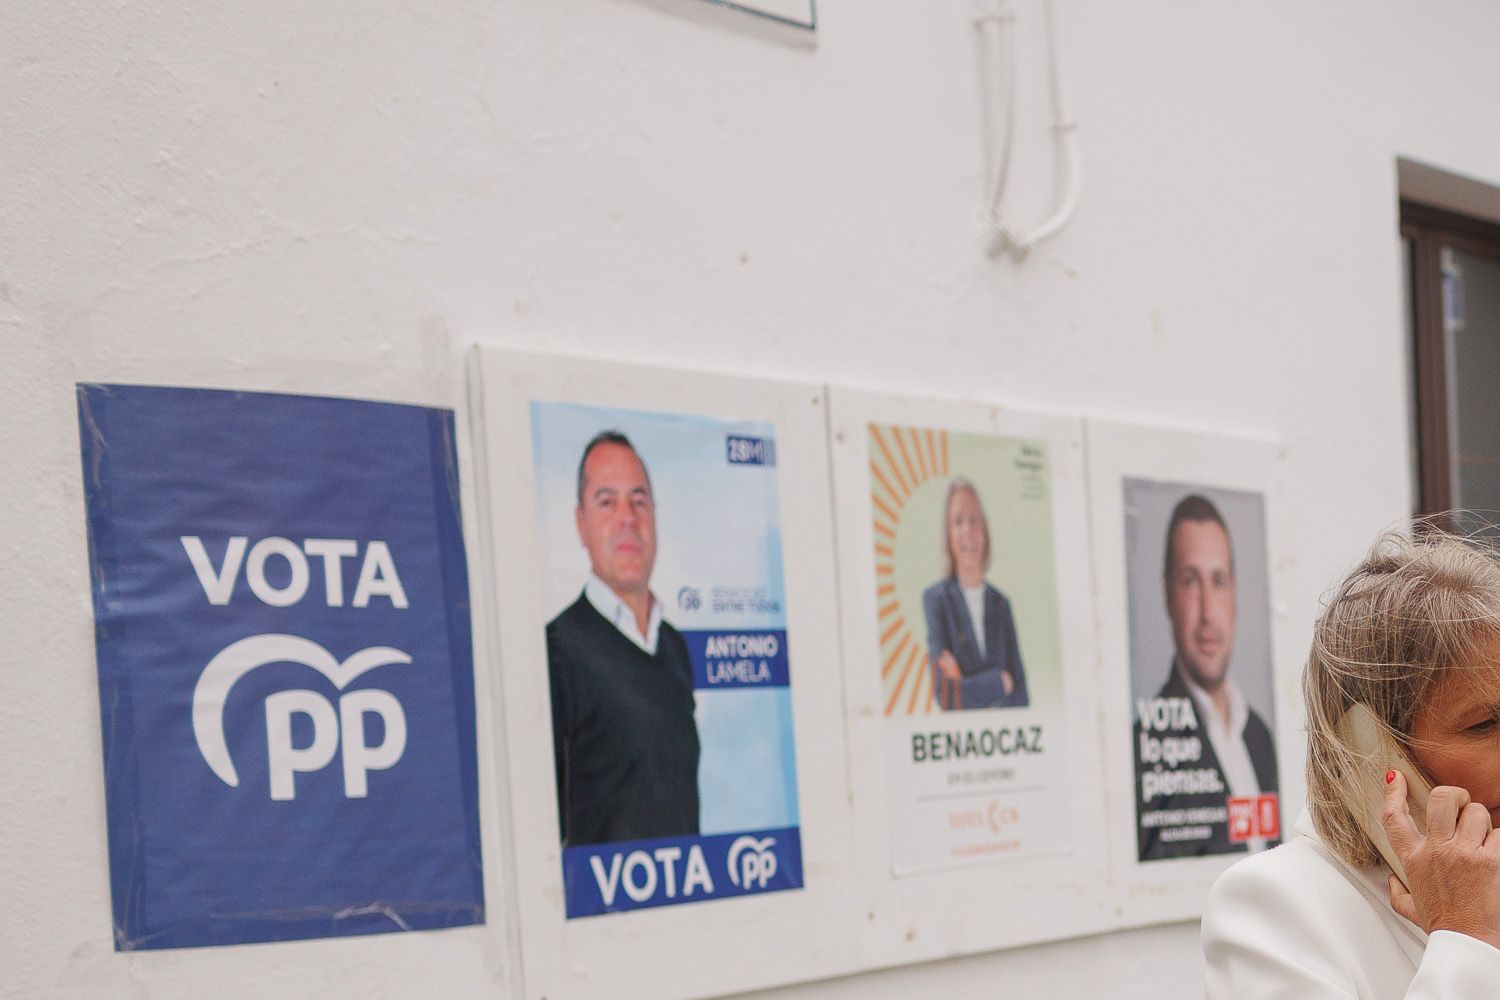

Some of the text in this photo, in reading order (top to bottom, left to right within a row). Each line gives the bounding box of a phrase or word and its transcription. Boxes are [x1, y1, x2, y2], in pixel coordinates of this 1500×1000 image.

[180, 536, 409, 609] VOTA
[705, 635, 778, 658] ANTONIO
[706, 660, 771, 684] LAMELA
[1138, 697, 1198, 731] VOTA
[911, 726, 1043, 763] BENAOCAZ
[1140, 732, 1201, 767] lo que
[590, 844, 714, 906] VOTA
